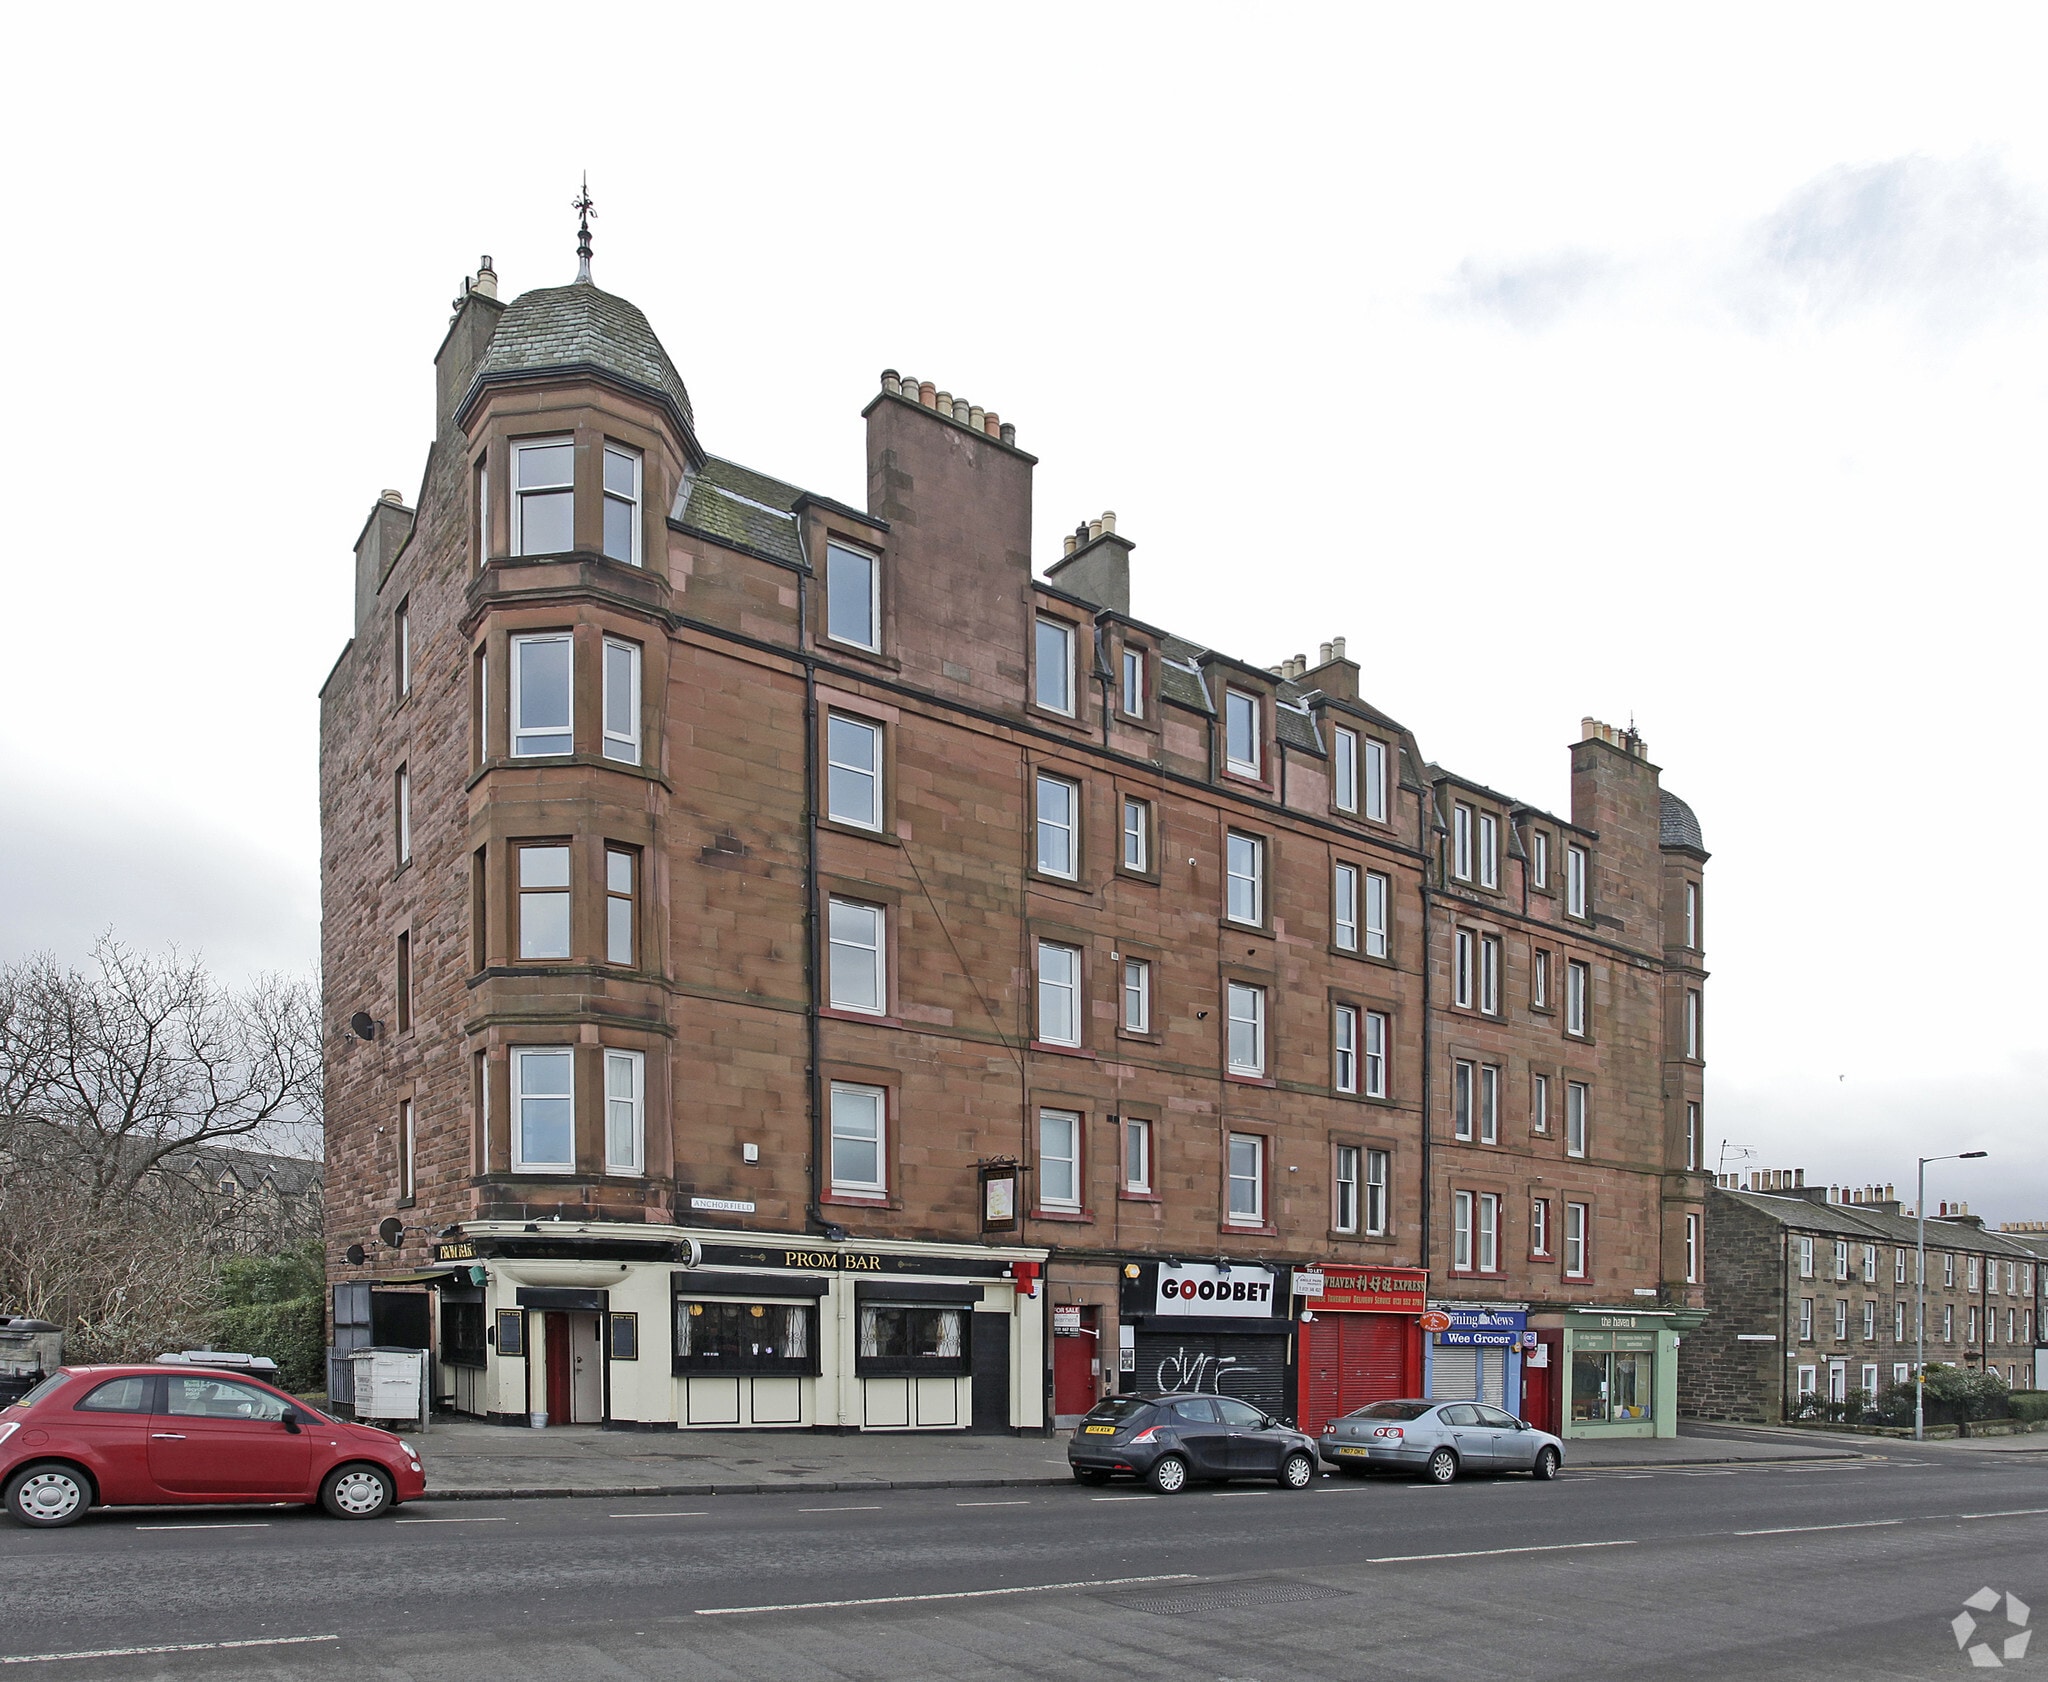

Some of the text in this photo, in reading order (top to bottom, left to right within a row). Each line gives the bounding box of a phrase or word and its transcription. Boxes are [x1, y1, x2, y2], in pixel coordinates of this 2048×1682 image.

[693, 1200, 754, 1211] ANCHORFIELD
[785, 1251, 881, 1270] PROM BAR
[1324, 1275, 1355, 1289] WHAVEN
[1394, 1279, 1425, 1292] EXPRESS
[1161, 1278, 1270, 1302] GOODBET
[1452, 1312, 1514, 1328] ening News
[1601, 1316, 1630, 1327] the haven
[1448, 1333, 1511, 1343] Wee Grocer
